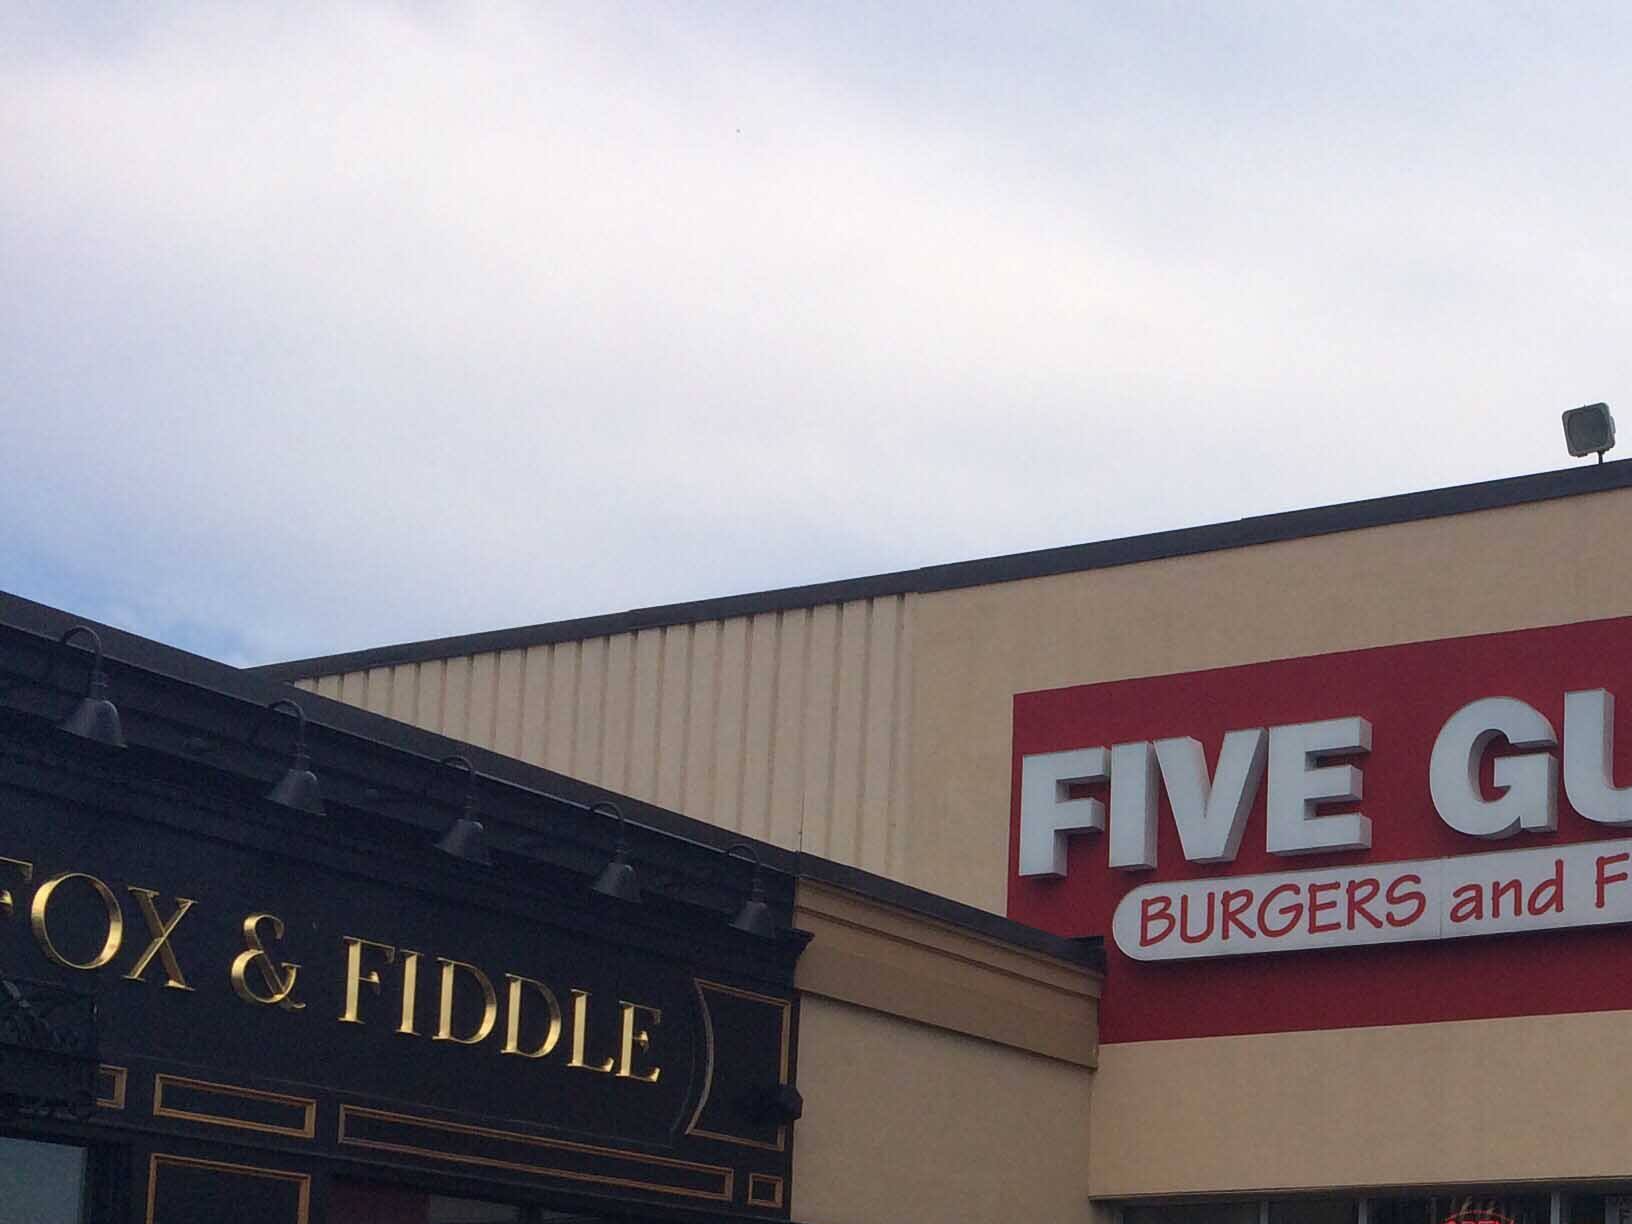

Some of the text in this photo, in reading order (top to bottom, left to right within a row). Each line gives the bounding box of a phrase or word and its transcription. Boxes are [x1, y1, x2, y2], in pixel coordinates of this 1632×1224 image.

[1019, 716, 1372, 879] FIVE
[1139, 875, 1426, 947] BURGERS
[1449, 858, 1564, 923] and
[231, 913, 306, 1009] &
[337, 935, 662, 1082] FIDDLE
